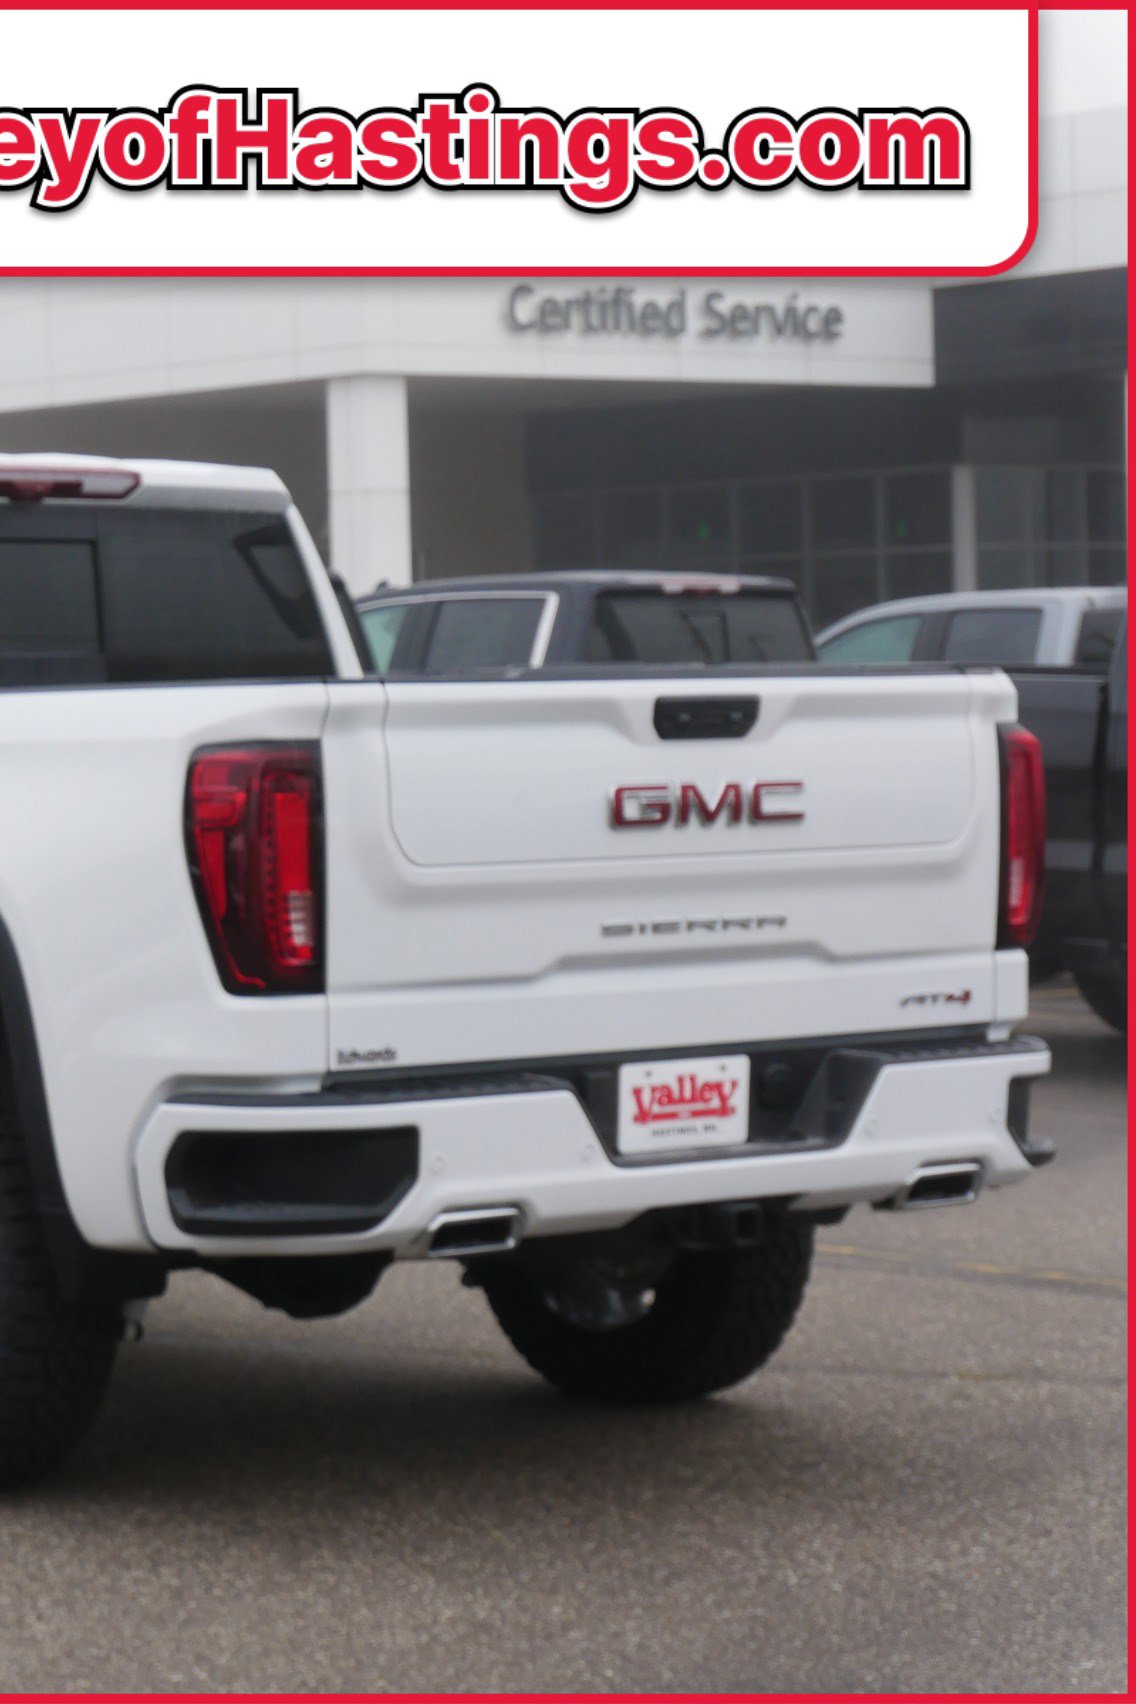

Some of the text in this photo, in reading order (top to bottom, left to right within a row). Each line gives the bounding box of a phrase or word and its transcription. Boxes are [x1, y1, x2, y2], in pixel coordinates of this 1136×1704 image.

[504, 284, 843, 341] Certified Service
[609, 779, 805, 830] GMC
[599, 915, 788, 938] SIERRA
[631, 1073, 739, 1125] Valley
